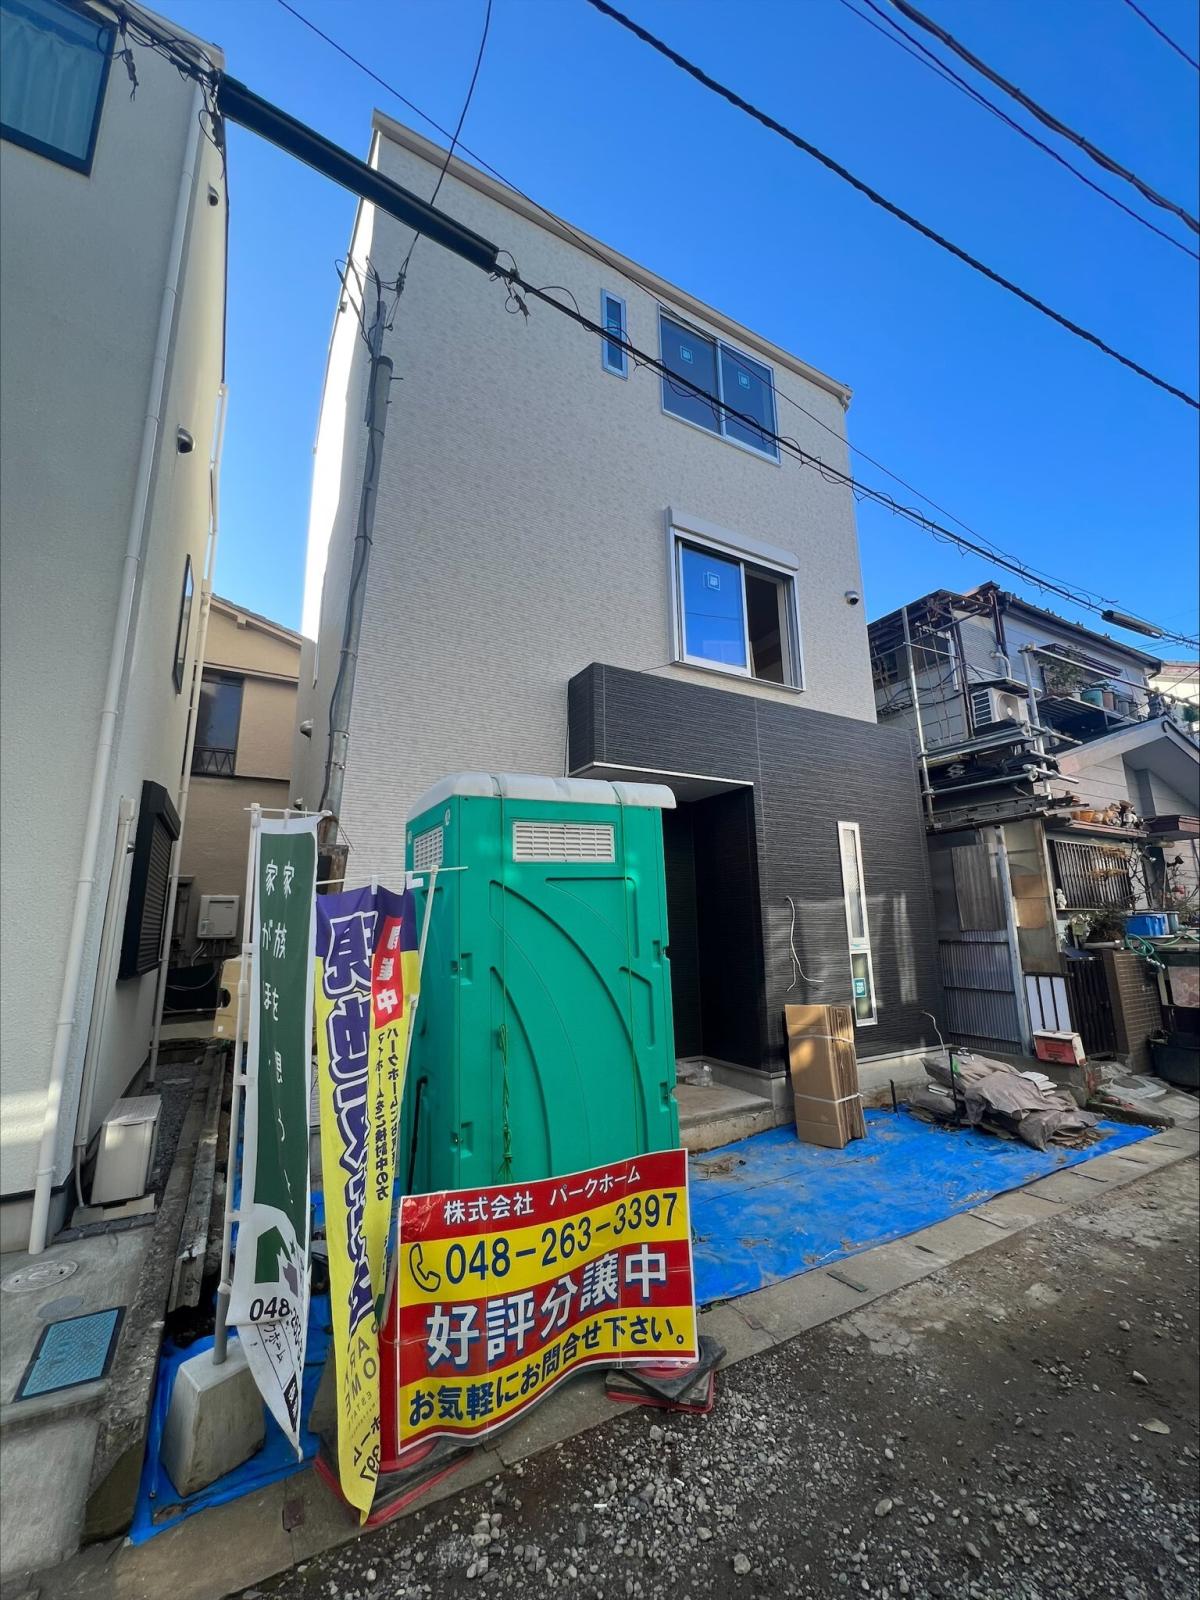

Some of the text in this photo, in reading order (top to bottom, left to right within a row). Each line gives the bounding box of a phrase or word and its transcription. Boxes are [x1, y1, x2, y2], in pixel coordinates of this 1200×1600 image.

[443, 1166, 641, 1226] 株式会社 パークホーム
[445, 1192, 679, 1285] 048-263-3397
[426, 1243, 667, 1370] 好評分譲中
[408, 1314, 685, 1427] お気軽にお問合せ下さい。
